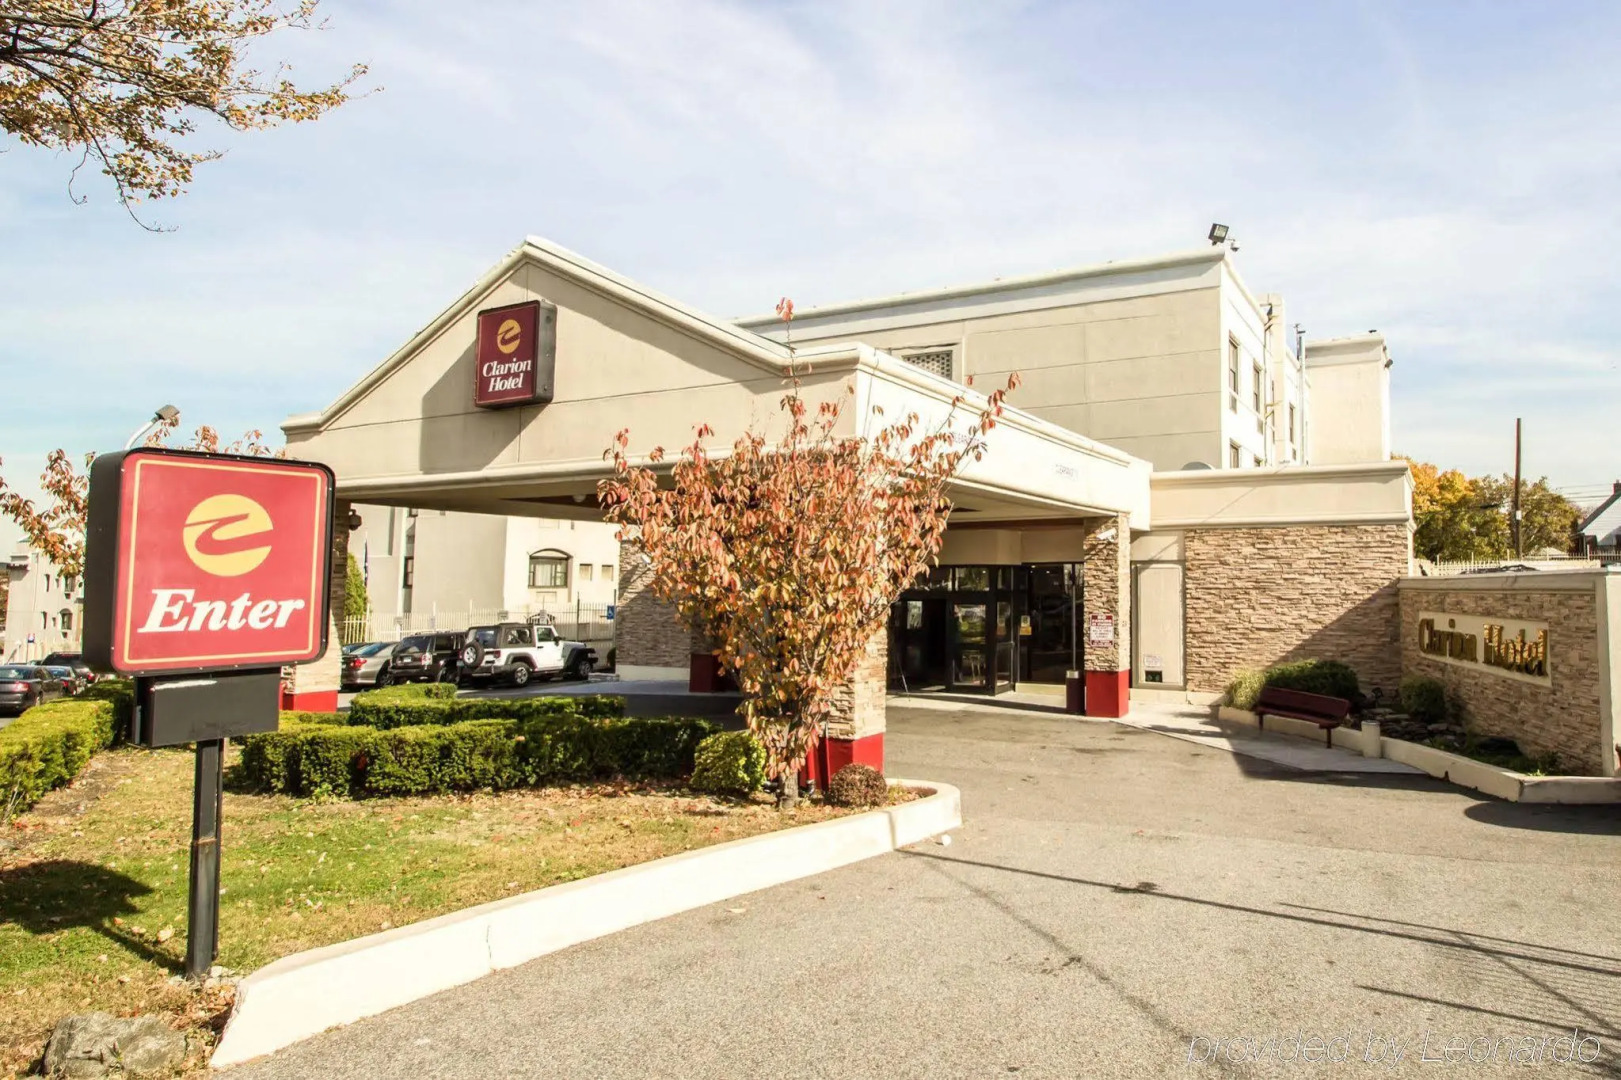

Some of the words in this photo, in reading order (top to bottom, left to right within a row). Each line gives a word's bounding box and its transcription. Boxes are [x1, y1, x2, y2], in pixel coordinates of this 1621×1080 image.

[482, 358, 531, 377] Clarion
[488, 373, 524, 392] Hotel
[137, 588, 306, 633] Enter
[1419, 618, 1478, 663] Clarion
[1482, 624, 1548, 676] Hotel
